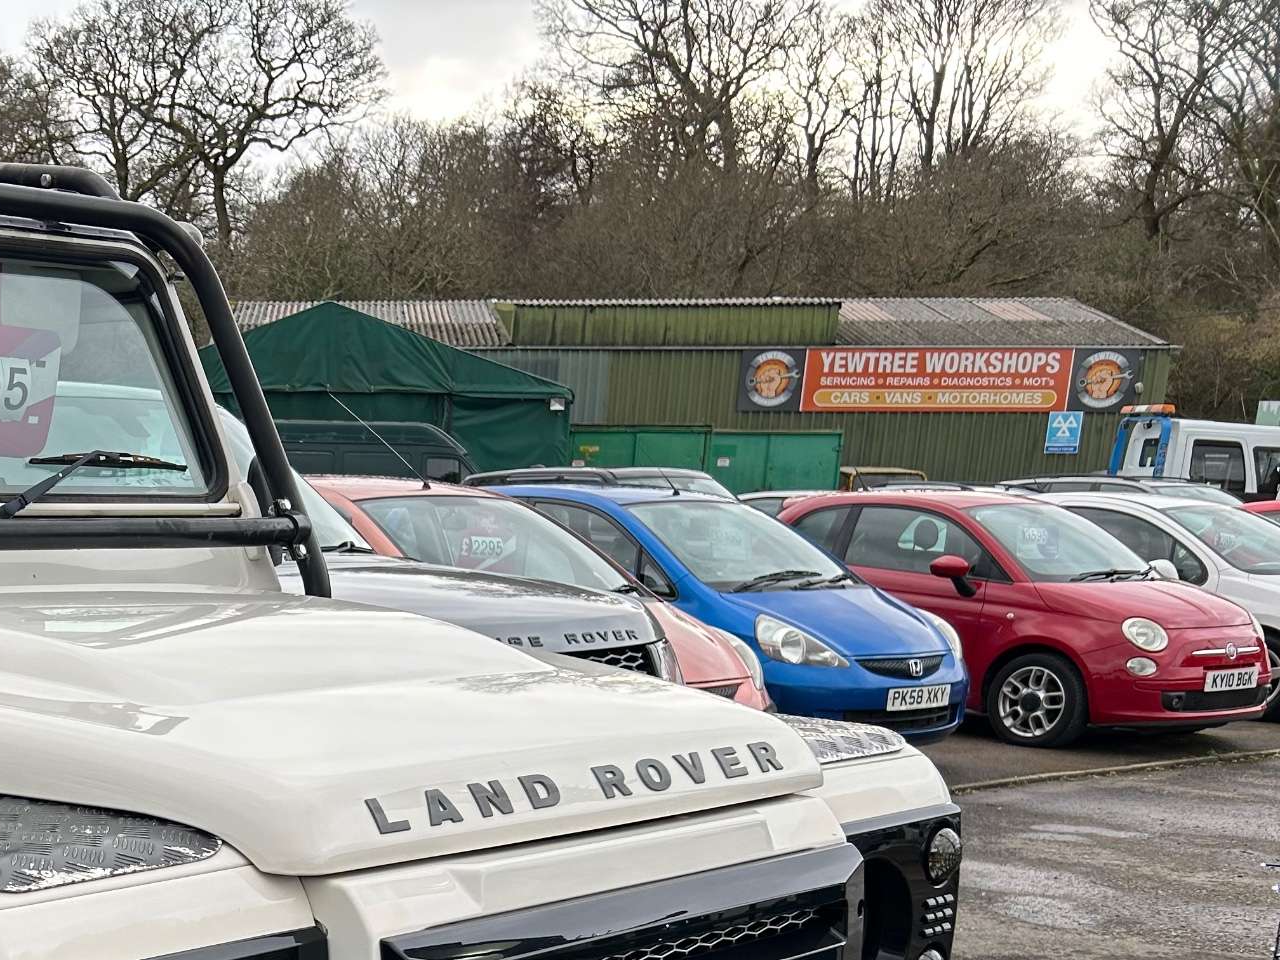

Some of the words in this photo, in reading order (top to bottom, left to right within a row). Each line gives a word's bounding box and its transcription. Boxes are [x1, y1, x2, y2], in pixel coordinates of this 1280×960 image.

[821, 351, 920, 374] YEWTREE
[925, 351, 1061, 374] WORKSHOPS
[820, 376, 876, 387] SERVICING
[886, 376, 931, 387] REPAIRS
[941, 376, 1013, 387] DIAGNOSTICS
[1023, 376, 1055, 387] MOT's
[831, 391, 870, 404] CARS
[884, 391, 922, 404] VANS
[936, 391, 1043, 405] MOTORHOMES
[564, 629, 639, 646] ROVER
[1211, 672, 1235, 689] KY10
[1235, 671, 1255, 687] BGK
[891, 688, 924, 707] PK58
[925, 686, 947, 704] XKY
[365, 774, 562, 835] LAND
[591, 741, 785, 799] ROVER
